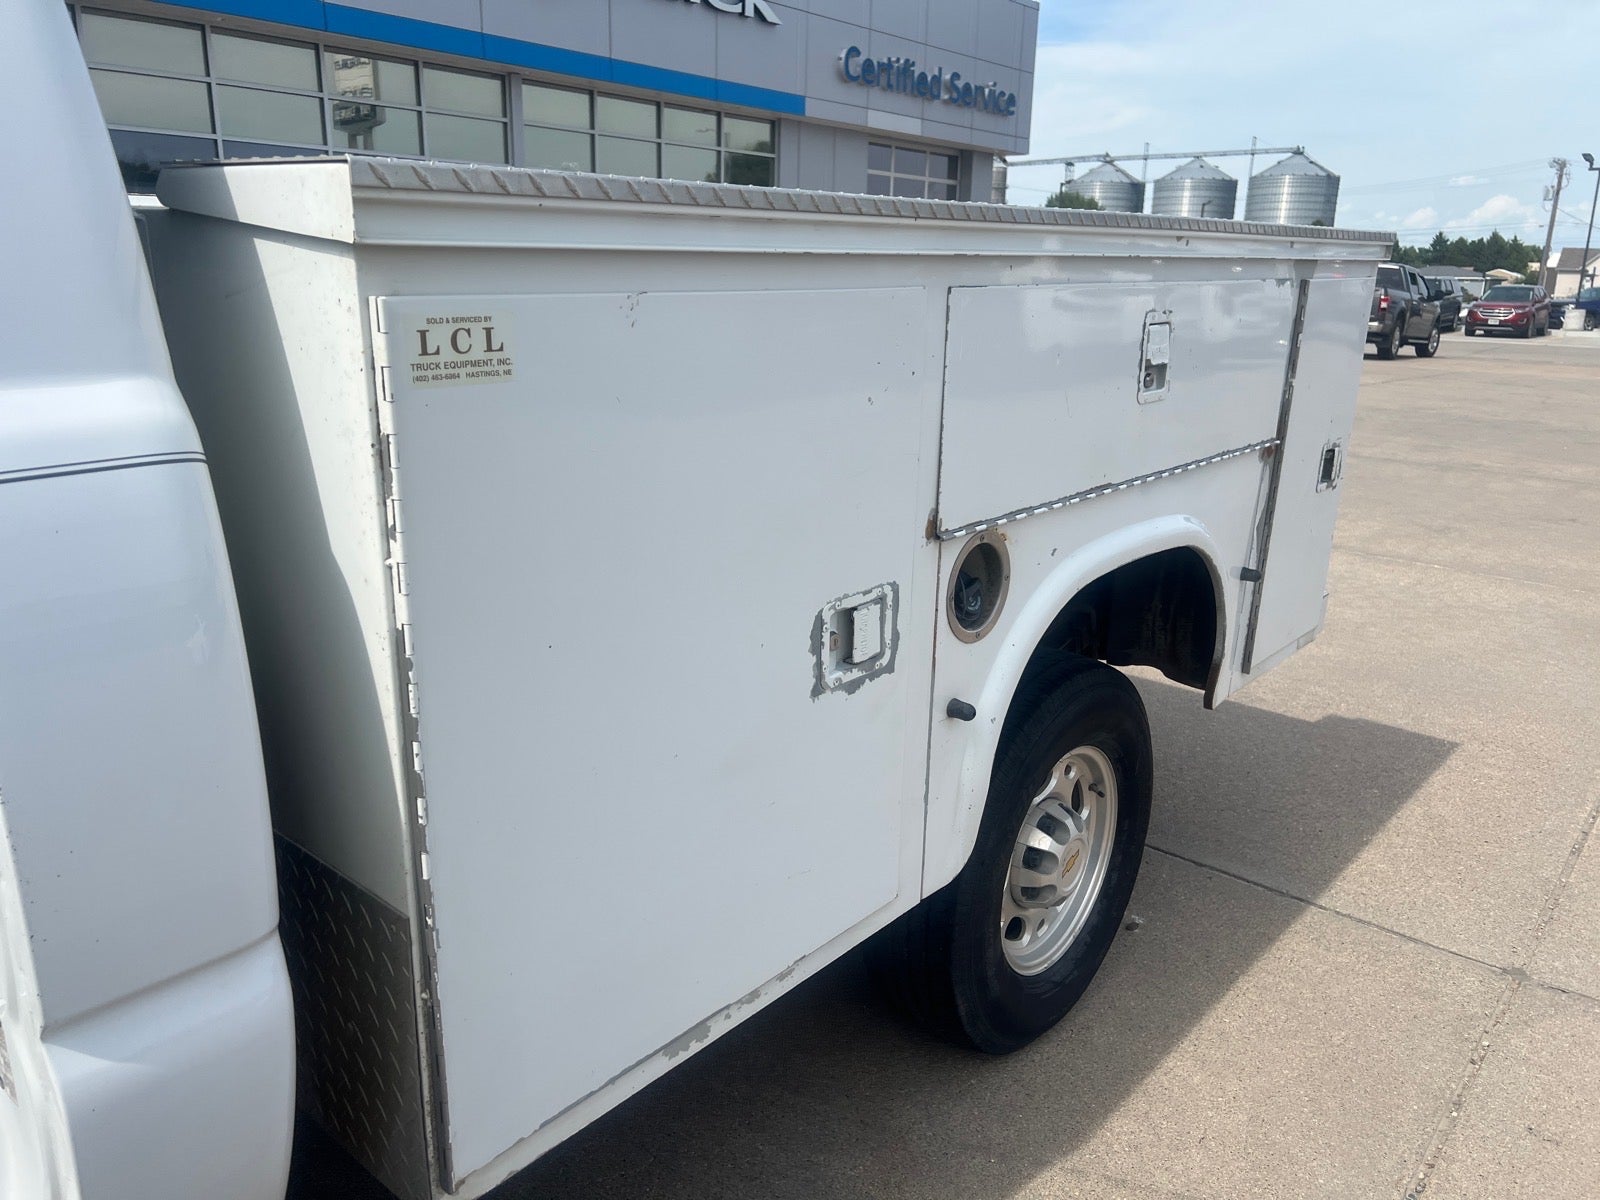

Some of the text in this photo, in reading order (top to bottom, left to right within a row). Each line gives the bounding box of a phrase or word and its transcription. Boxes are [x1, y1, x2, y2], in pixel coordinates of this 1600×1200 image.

[841, 45, 1016, 117] Certified Service
[410, 357, 513, 372] TRUCK EQUIPMENT, INC.
[412, 375, 430, 384] (402)
[466, 370, 501, 379] HASTINGS,
